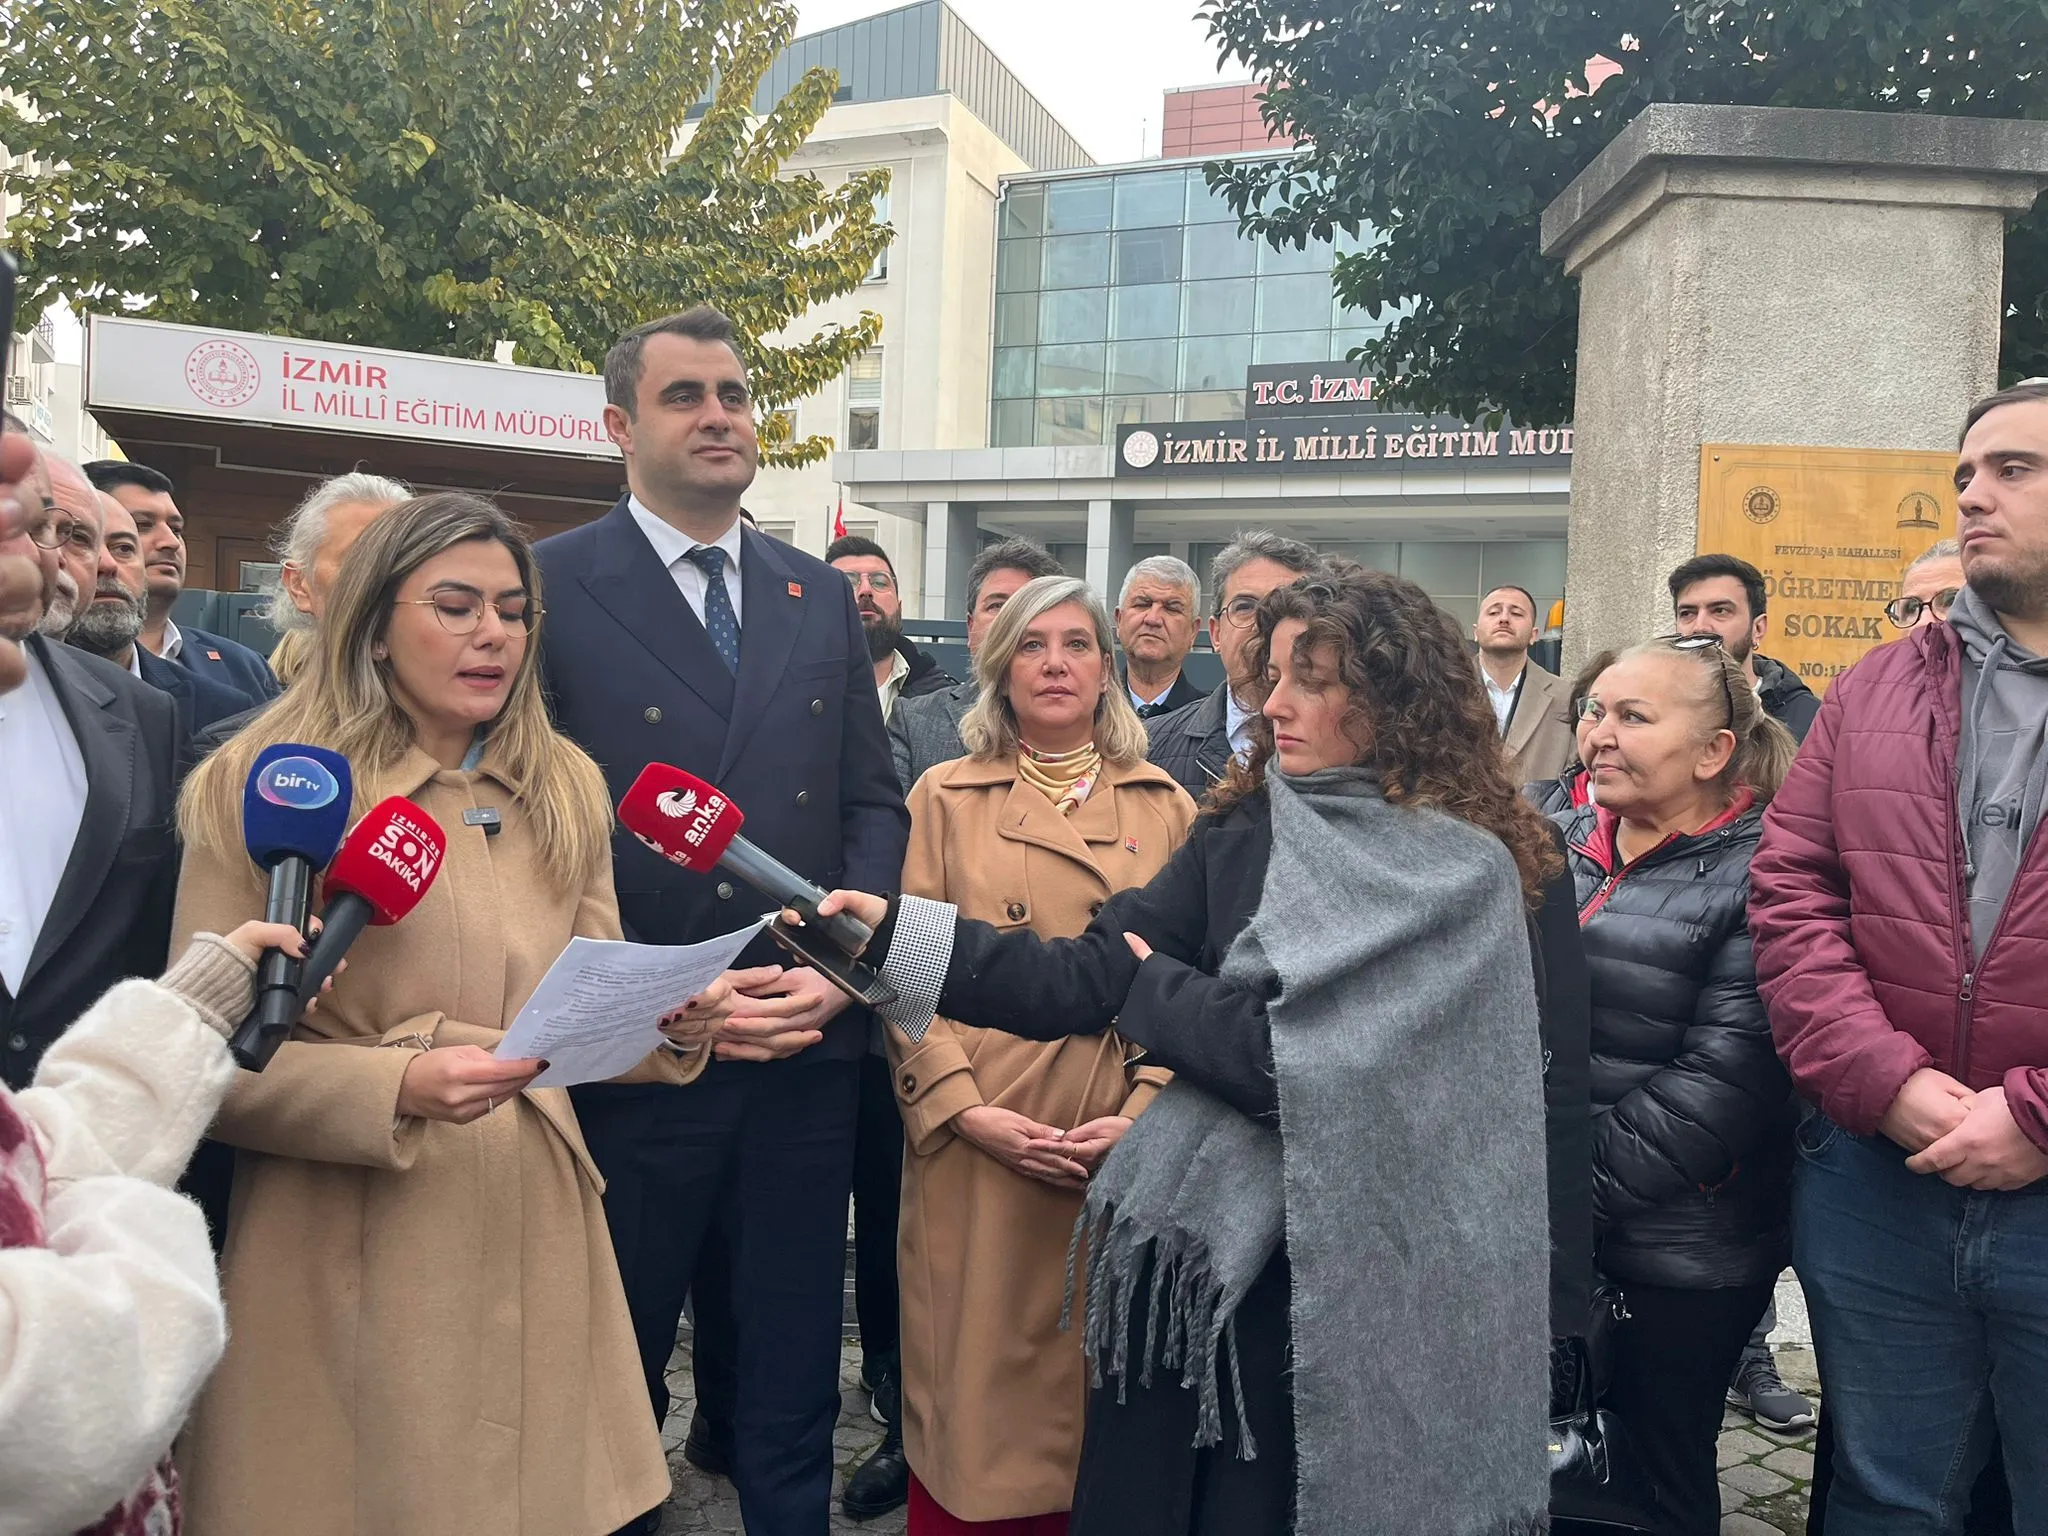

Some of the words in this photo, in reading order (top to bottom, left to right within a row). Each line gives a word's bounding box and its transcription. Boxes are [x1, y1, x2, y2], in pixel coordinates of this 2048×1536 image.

[283, 352, 387, 389] İZMİR
[1253, 380, 1304, 405] T.C.
[1309, 374, 1378, 402] İZM
[283, 384, 304, 412] İL
[314, 390, 388, 420] MİLLÎ
[396, 398, 485, 430] EĞİTİM
[495, 409, 614, 443] MÜDÜRL
[1163, 431, 1248, 464] İZMİR
[1256, 429, 1285, 462] İL
[1293, 426, 1377, 461] MİLLÎ
[1384, 423, 1499, 458] EĞİTİM
[1774, 544, 1834, 559] FEVZİPAŞA
[1836, 546, 1901, 560] MAHALLESİ
[1784, 614, 1883, 639] SOKAK
[684, 795, 723, 844] anka
[379, 825, 435, 880] SON
